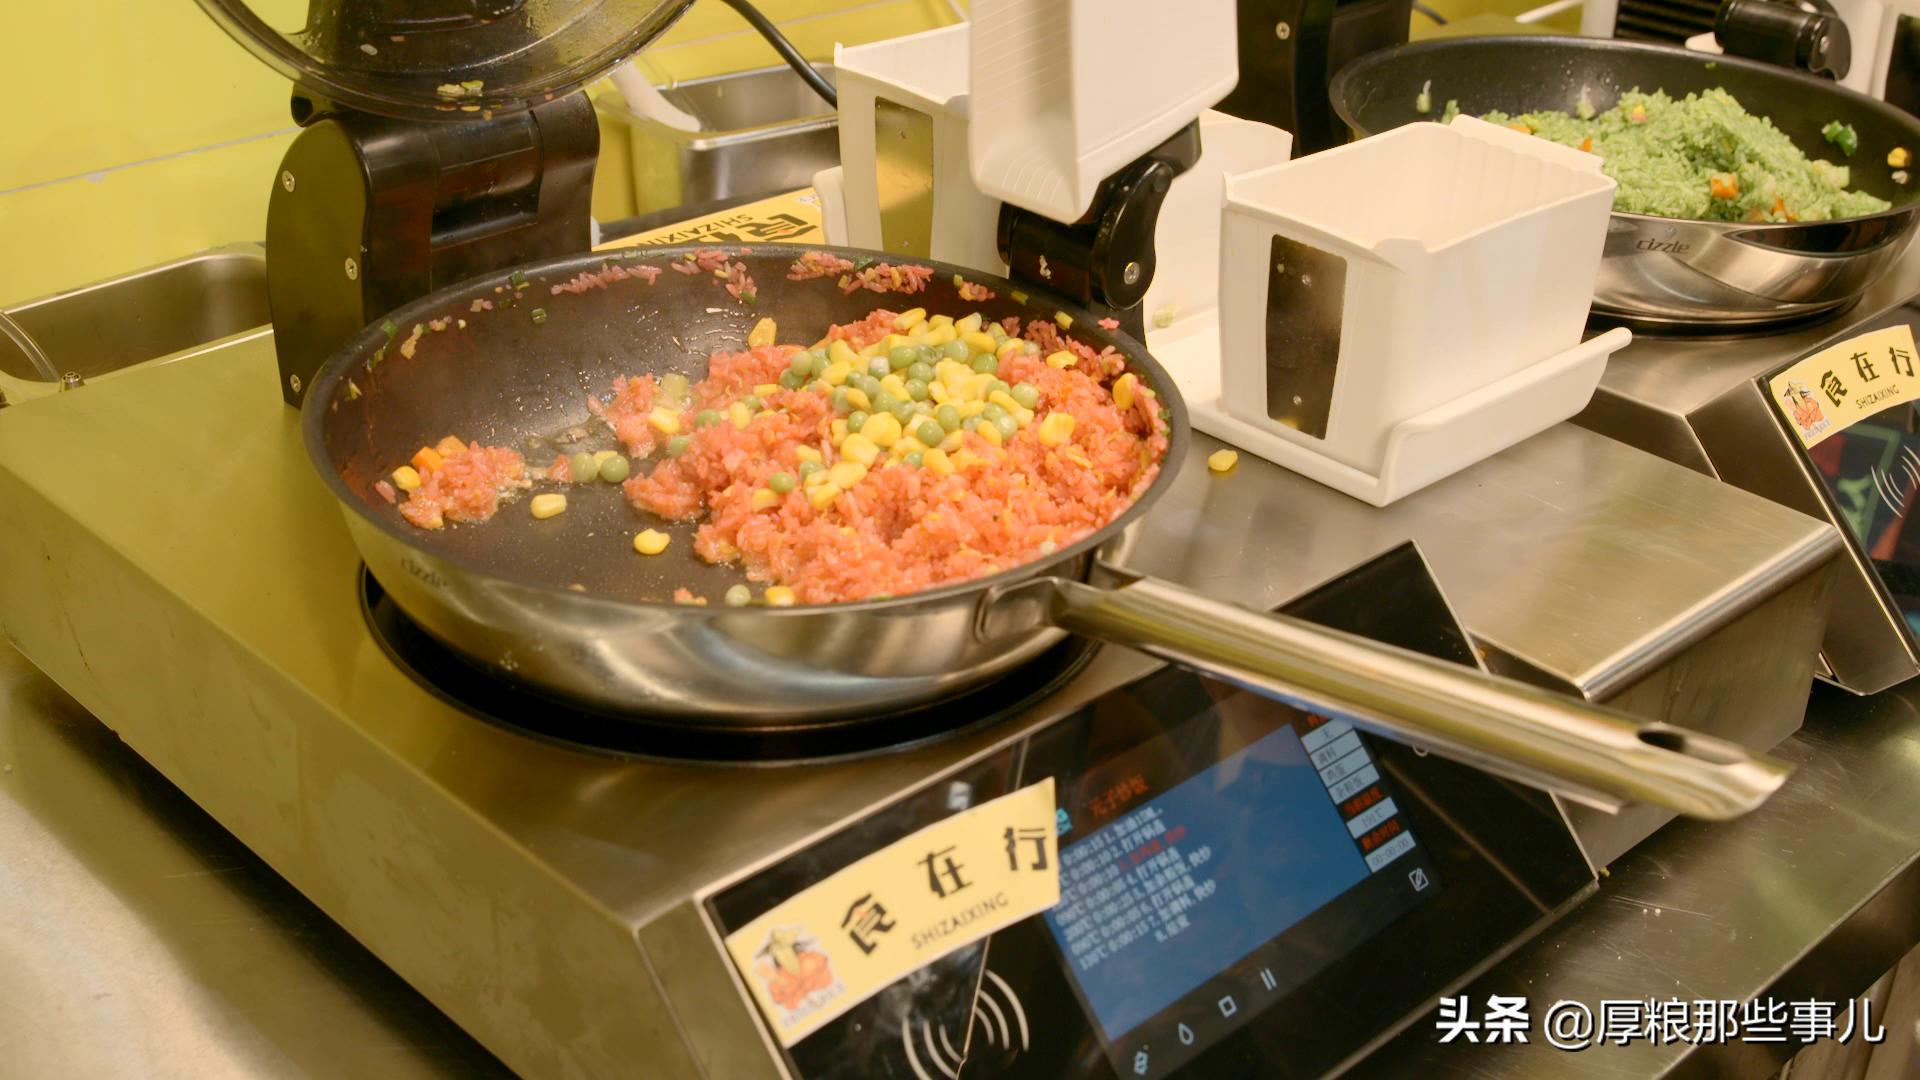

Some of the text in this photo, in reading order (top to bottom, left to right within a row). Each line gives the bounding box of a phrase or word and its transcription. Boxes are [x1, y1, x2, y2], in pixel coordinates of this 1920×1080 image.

[1636, 238, 1690, 254] cizzle
[1820, 346, 1915, 408] 食在行
[1856, 384, 1900, 409] SHIZAIXING
[841, 827, 1048, 956] 食在行
[911, 891, 1009, 950] SHIZAIXING
